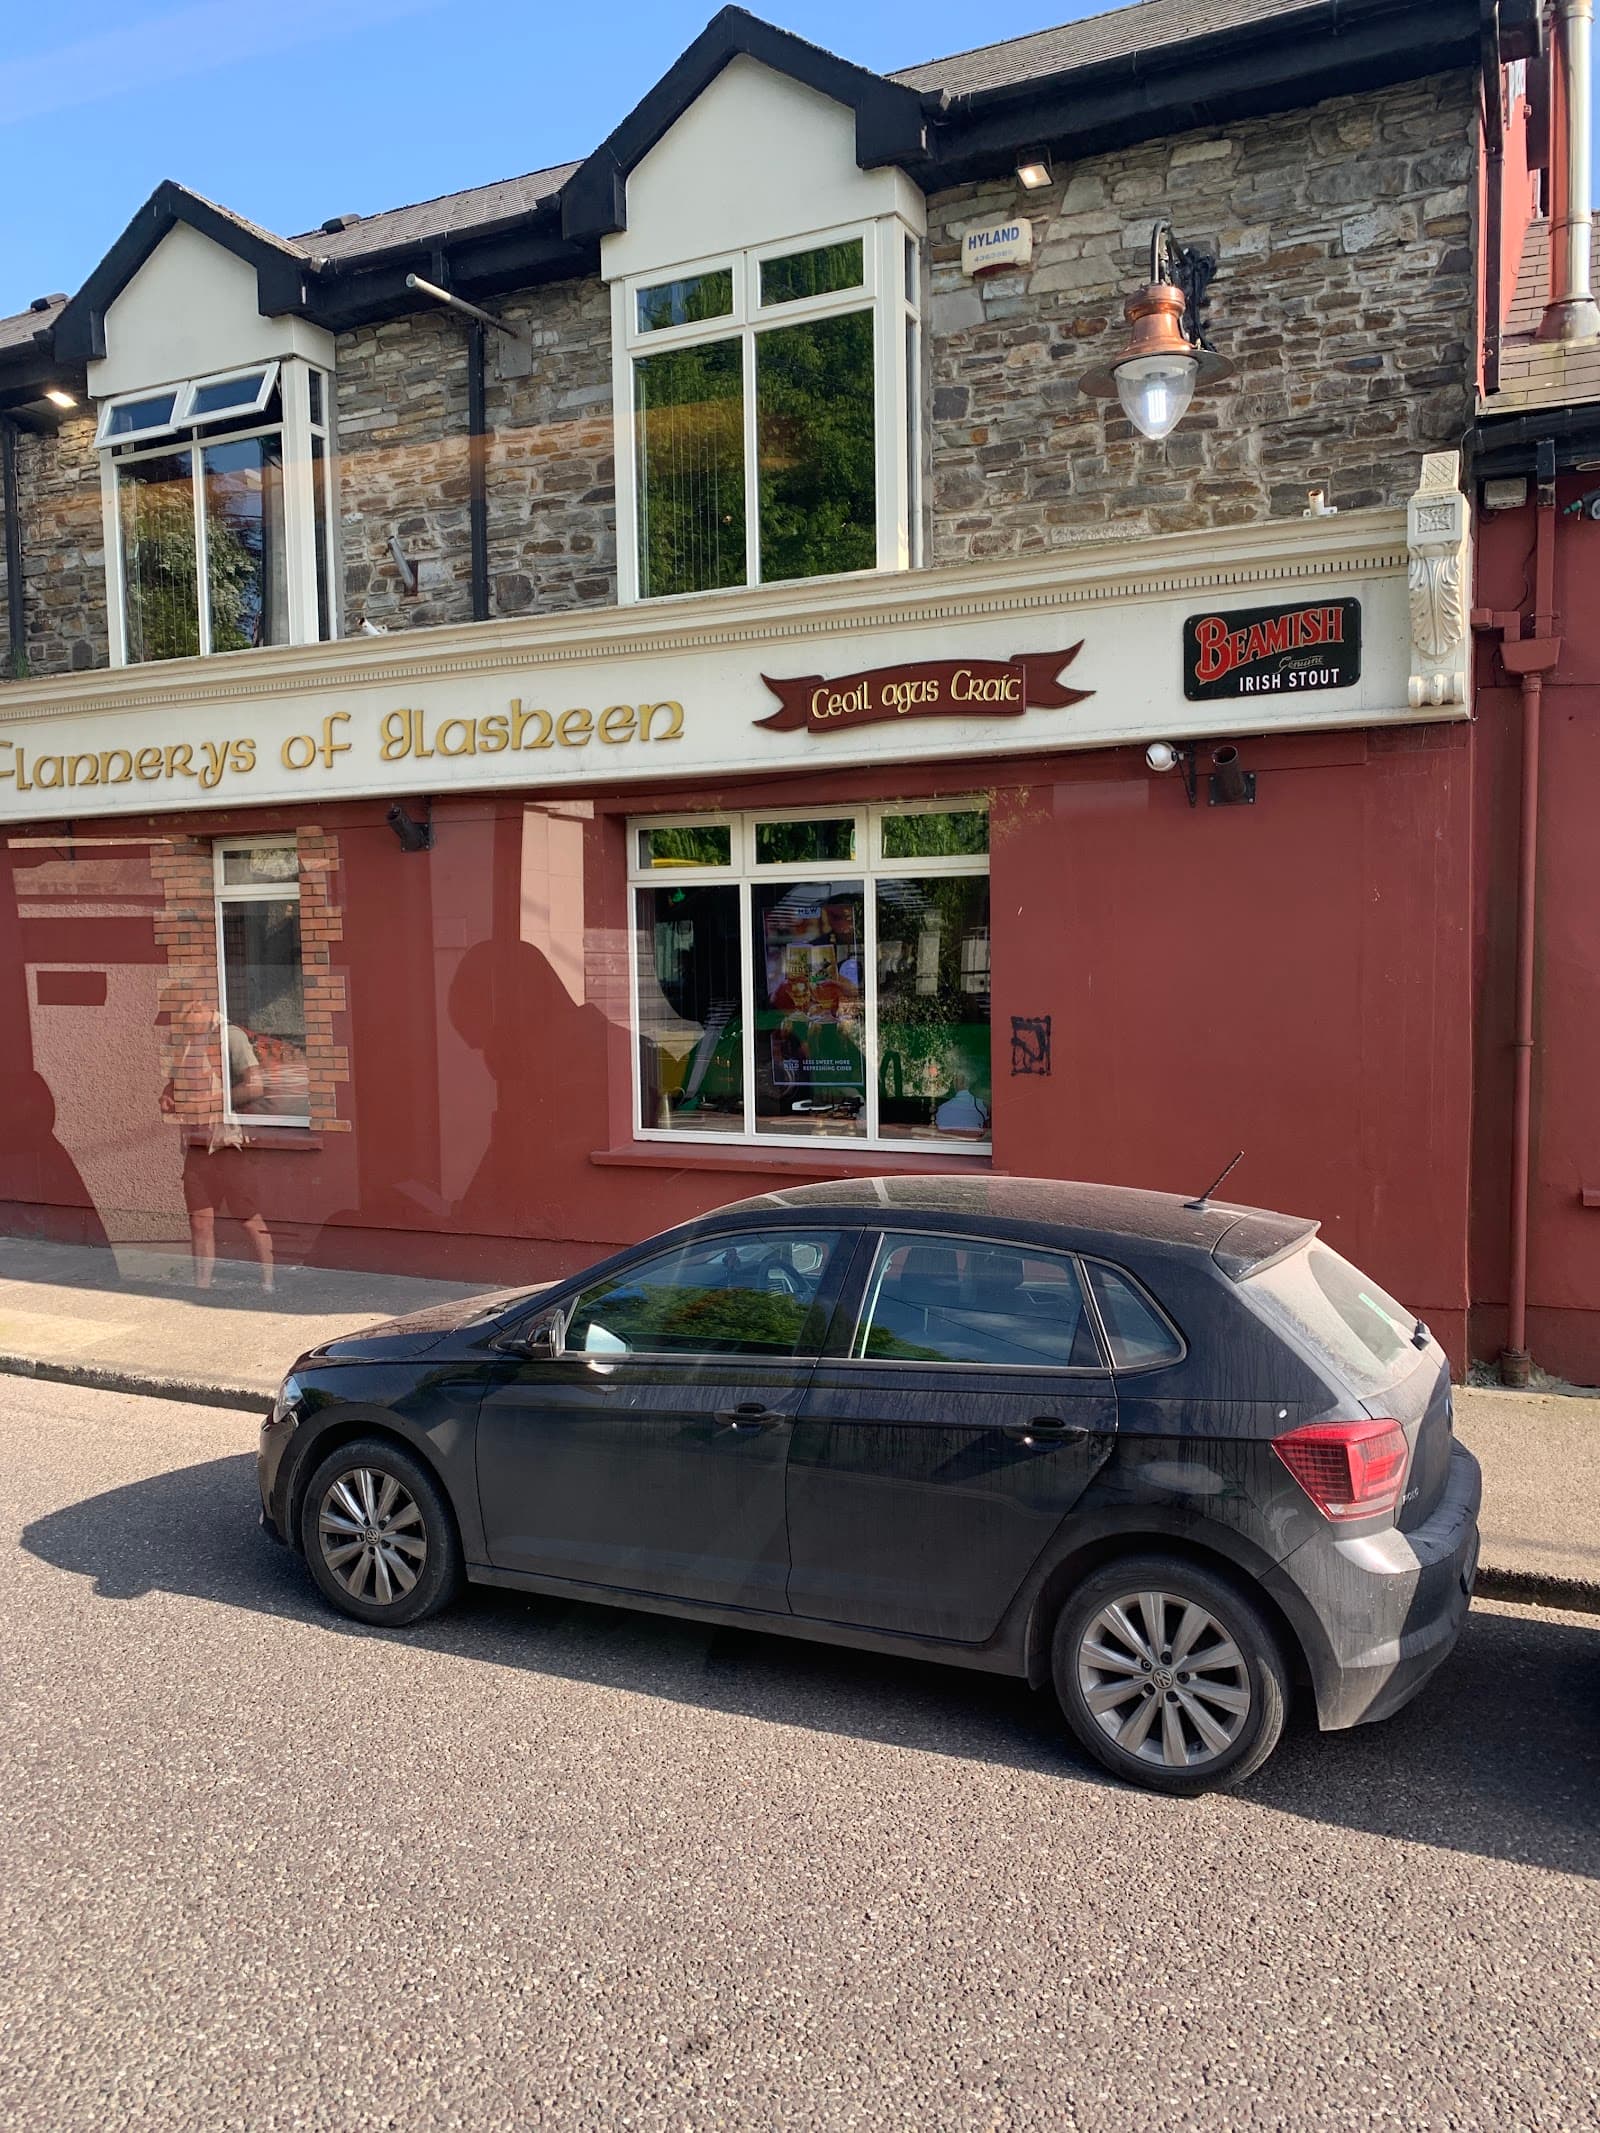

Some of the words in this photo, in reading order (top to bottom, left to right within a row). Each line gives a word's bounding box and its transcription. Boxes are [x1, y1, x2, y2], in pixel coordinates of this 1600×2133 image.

[968, 227, 1020, 250] HYLAND
[1195, 606, 1345, 685] BEAMISH
[881, 679, 940, 714] agus
[1239, 673, 1281, 692] IRISH
[1288, 668, 1340, 687] STOUT
[281, 711, 353, 770] of
